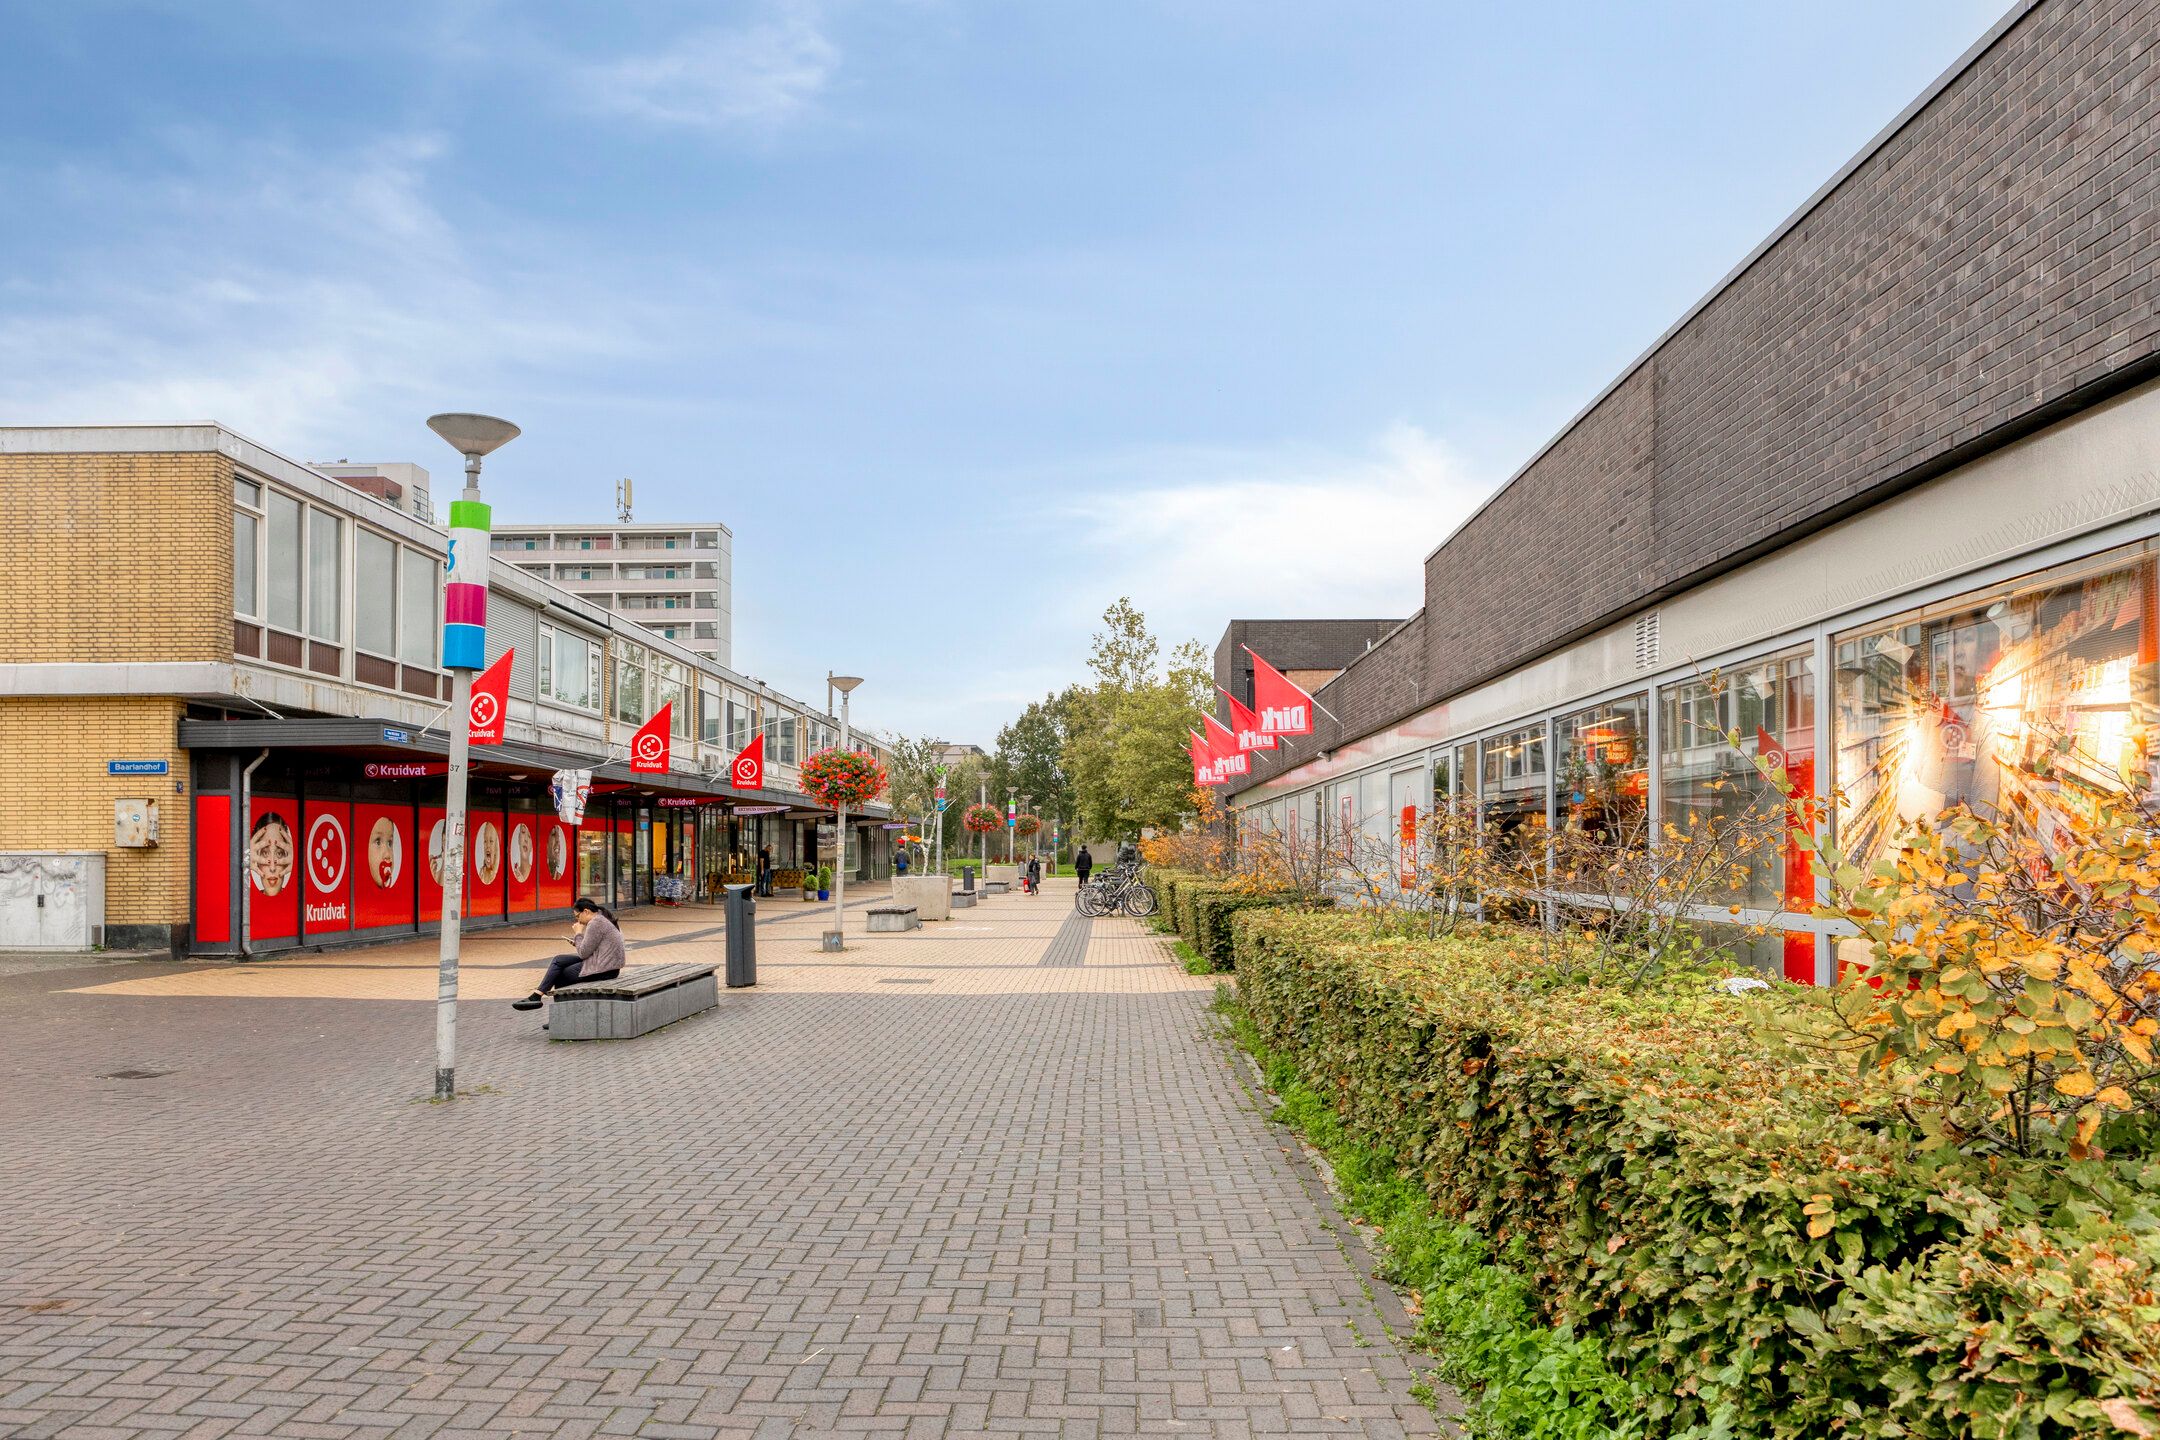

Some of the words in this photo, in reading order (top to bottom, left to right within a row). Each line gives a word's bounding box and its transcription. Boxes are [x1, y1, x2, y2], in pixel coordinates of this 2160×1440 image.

[114, 763, 161, 771] Baarlandhof
[450, 764, 460, 772] 37
[636, 761, 662, 769] Kruidvat
[380, 765, 426, 776] Kruidvat
[667, 798, 696, 806] Kruidvat
[306, 903, 346, 922] Kruidvat
